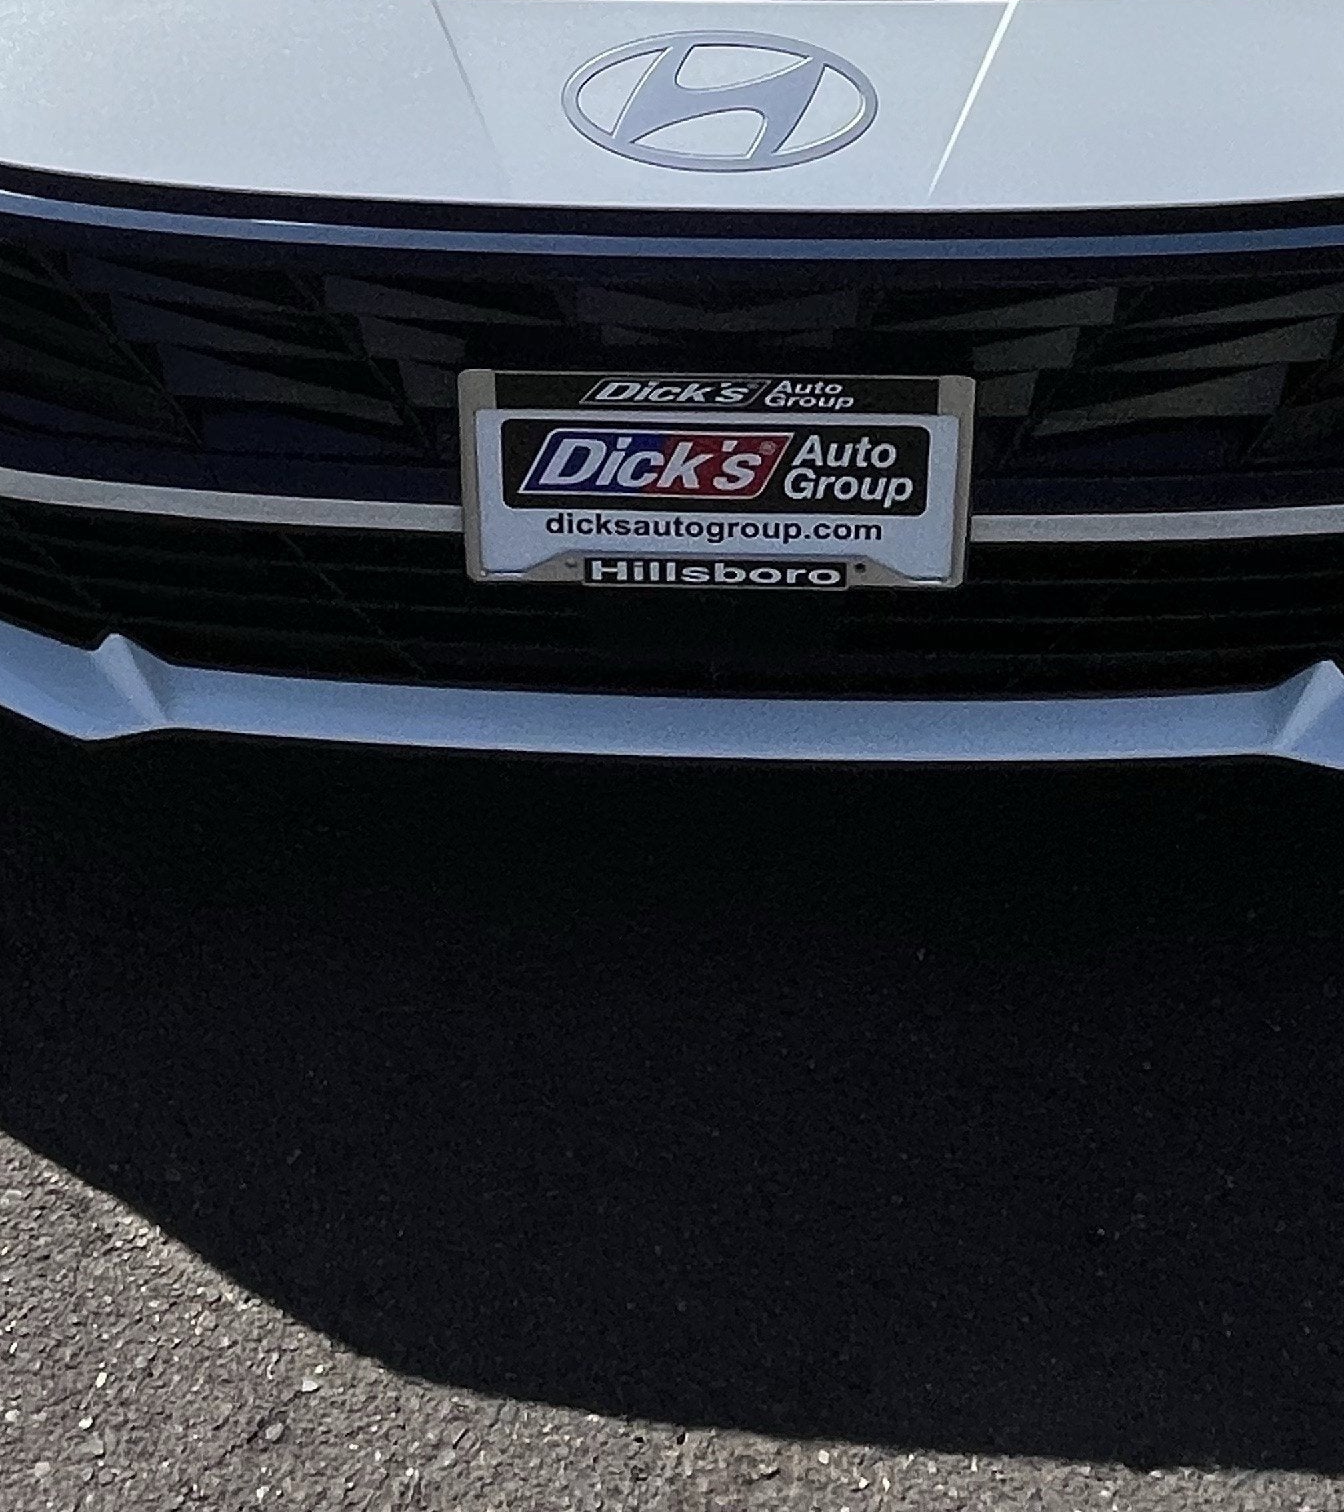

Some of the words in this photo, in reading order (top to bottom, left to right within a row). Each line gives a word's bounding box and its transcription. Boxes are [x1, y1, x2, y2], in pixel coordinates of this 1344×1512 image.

[595, 381, 749, 402] Dick's
[773, 380, 843, 394] Auto
[764, 394, 854, 410] Group
[539, 436, 764, 491] Dick's
[791, 434, 897, 469] Auto
[783, 469, 914, 507] Group
[546, 513, 883, 544] dicksautogroup.com
[591, 559, 841, 585] Hillsboro
